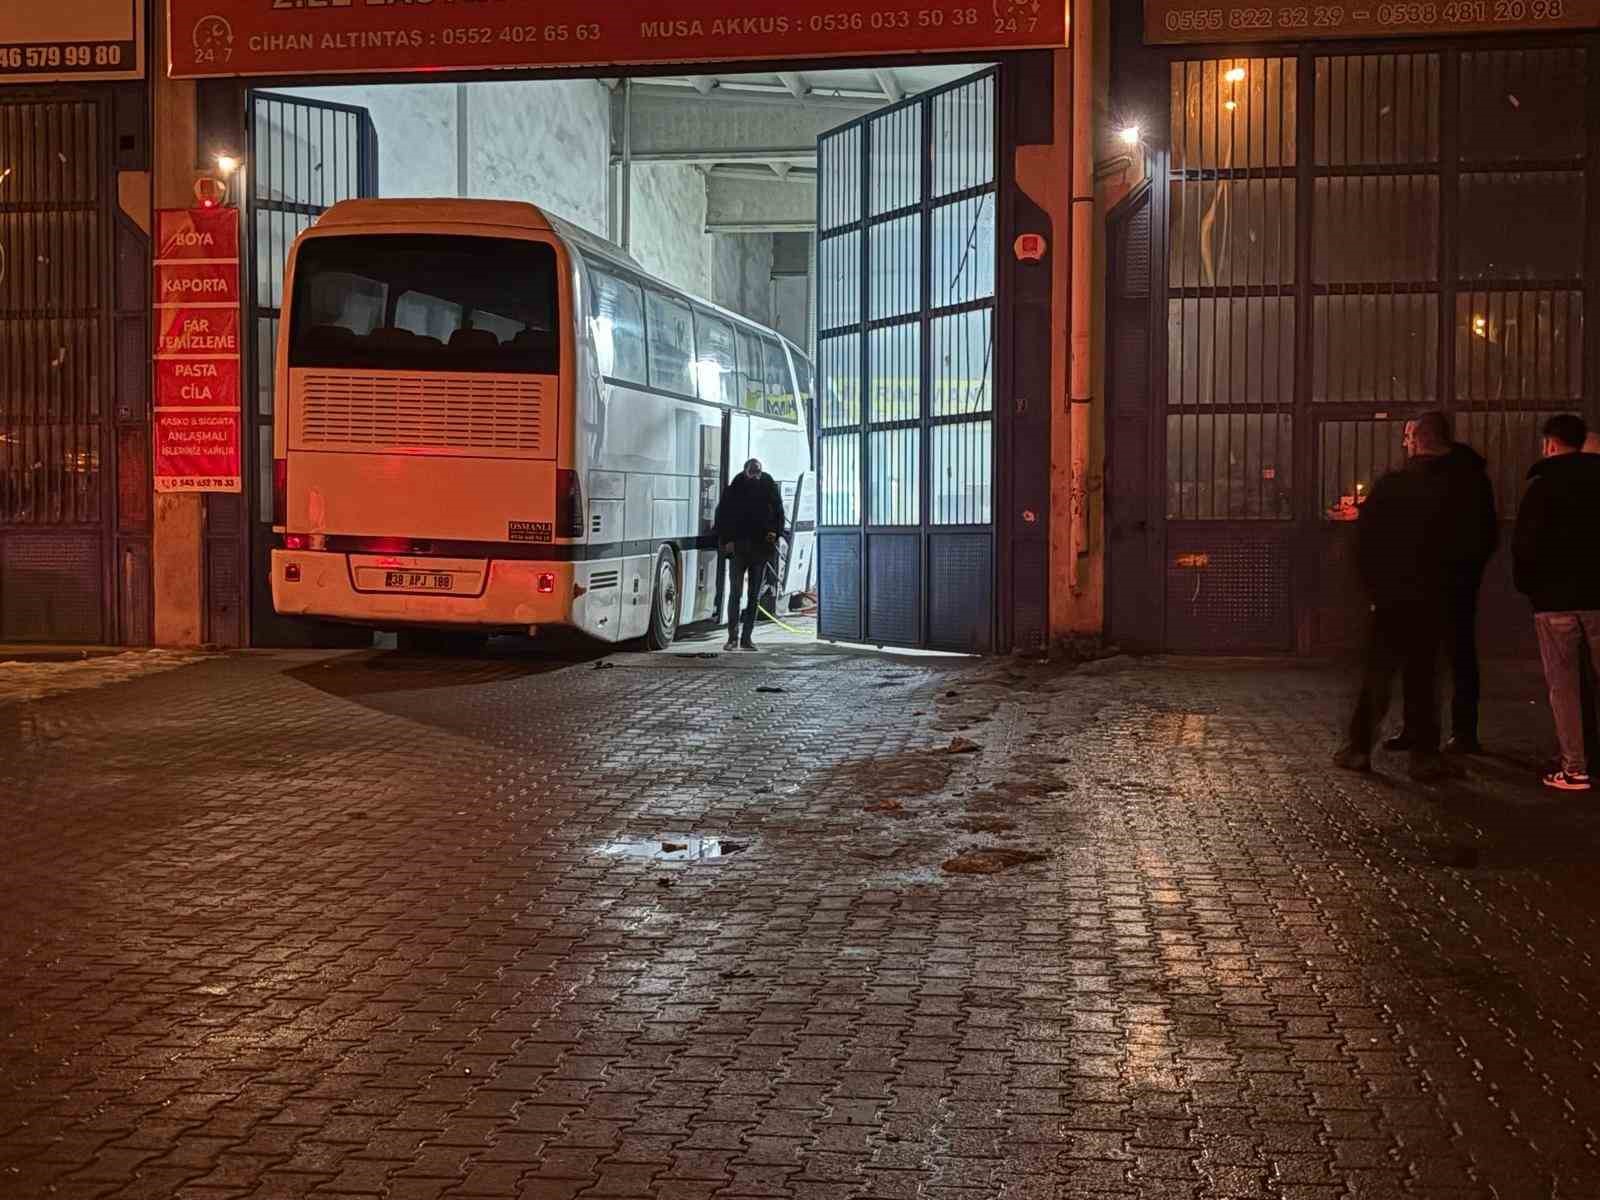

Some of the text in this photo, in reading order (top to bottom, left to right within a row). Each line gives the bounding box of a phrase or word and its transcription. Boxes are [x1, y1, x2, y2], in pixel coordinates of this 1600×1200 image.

[640, 19, 704, 39] MUSA
[710, 16, 790, 36] AKKUŞ
[809, 12, 863, 32] 0536
[871, 12, 909, 29] 033
[917, 9, 944, 27] 50
[951, 8, 978, 26] 38
[1165, 10, 1223, 31] 0555
[1228, 9, 1272, 29] 822
[1278, 7, 1307, 28] 32
[1312, 6, 1344, 27] 29
[1377, 4, 1436, 24] 0538
[1442, 2, 1486, 22] 481
[1493, 1, 1525, 20] 20
[1530, 0, 1562, 19] 98
[249, 32, 313, 51] CİHAN
[320, 29, 423, 50] ALTINTAŞ
[442, 27, 492, 45] 0552
[499, 26, 537, 43] 402
[543, 24, 569, 42] 65
[575, 23, 602, 41] 63
[25, 46, 61, 67] 579
[65, 46, 91, 66] 99
[95, 45, 121, 65] 80
[165, 278, 228, 292] KAPORTA
[183, 319, 209, 333] FAR
[175, 363, 217, 377] PASTA
[180, 383, 212, 400] CİLA
